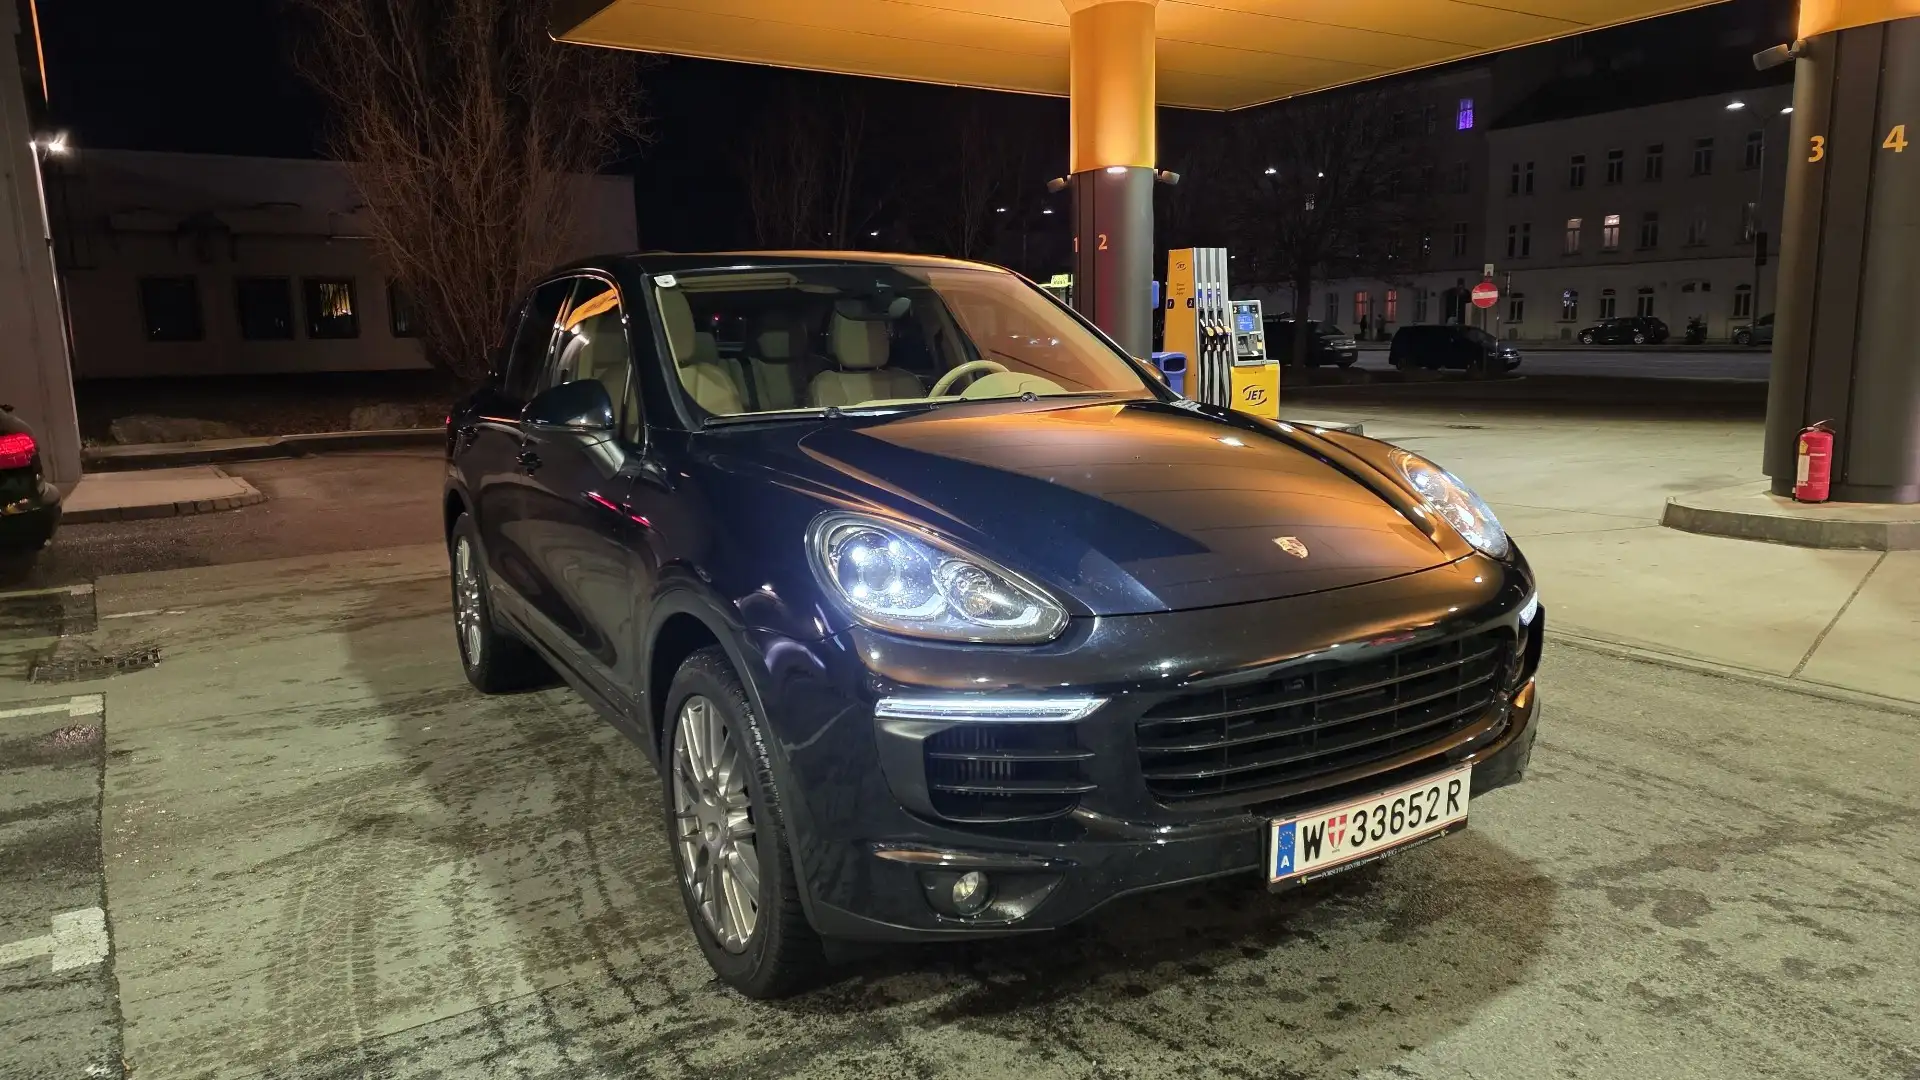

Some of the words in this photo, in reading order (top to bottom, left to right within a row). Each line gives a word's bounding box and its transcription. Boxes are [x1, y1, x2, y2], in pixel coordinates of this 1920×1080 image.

[1882, 124, 1908, 153] 4
[1808, 135, 1825, 163] 3
[1073, 236, 1079, 253] 1
[1098, 233, 1108, 251] 2
[1245, 389, 1265, 401] JET
[1302, 820, 1326, 863] W
[1350, 786, 1441, 847] 33652
[1446, 778, 1462, 816] R
[1280, 855, 1290, 869] A
